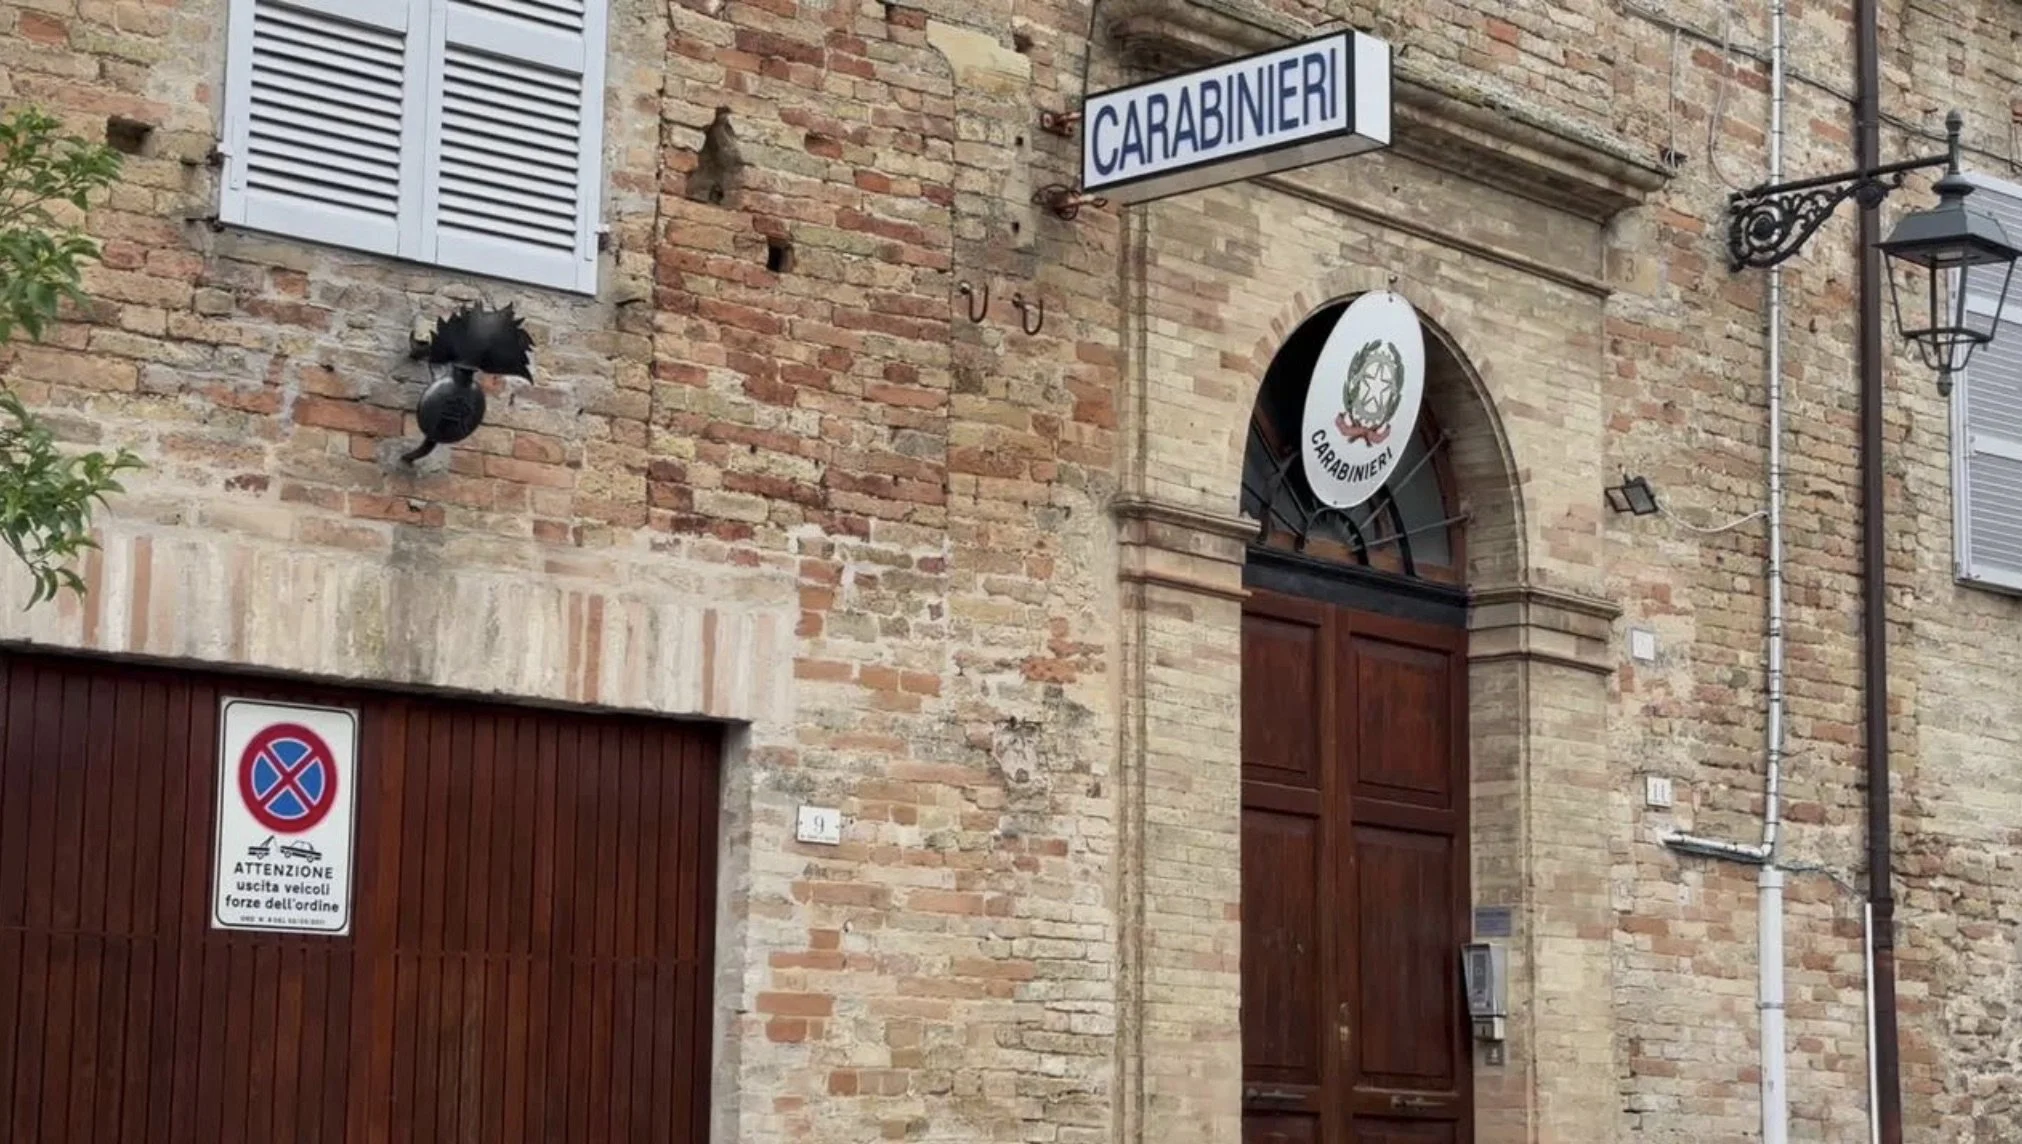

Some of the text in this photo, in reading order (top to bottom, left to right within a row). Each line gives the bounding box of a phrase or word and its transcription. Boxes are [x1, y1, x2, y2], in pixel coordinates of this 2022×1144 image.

[1092, 47, 1337, 176] CARABINIERI
[1311, 429, 1393, 483] CARABINIERI
[814, 815, 824, 834] 9
[234, 861, 334, 879] ATTENZIONE
[236, 880, 330, 896] uscita veicoli
[225, 894, 339, 913] forze dell'ordine
